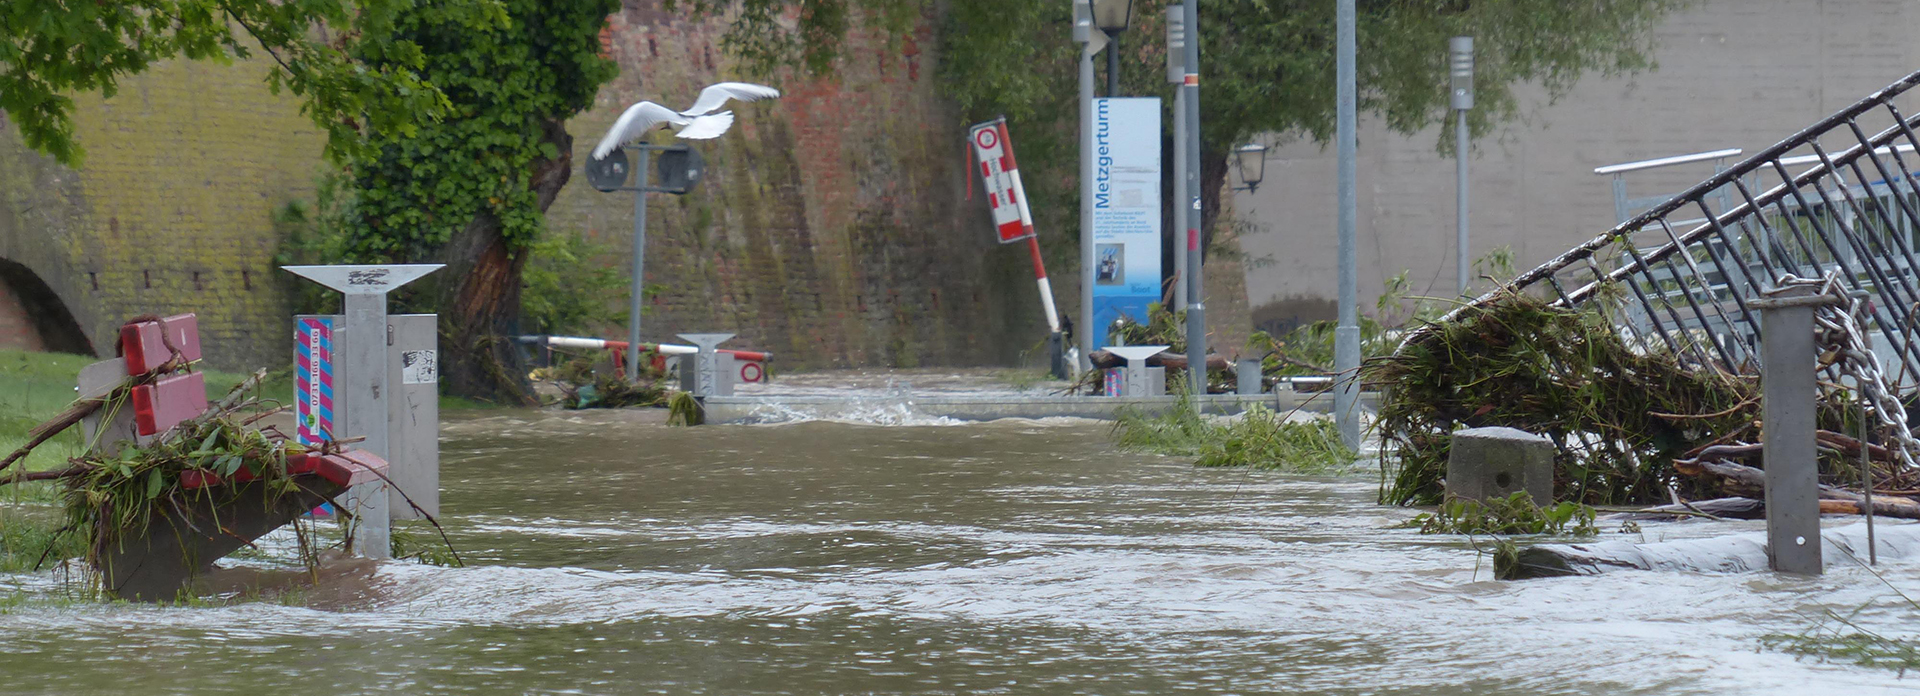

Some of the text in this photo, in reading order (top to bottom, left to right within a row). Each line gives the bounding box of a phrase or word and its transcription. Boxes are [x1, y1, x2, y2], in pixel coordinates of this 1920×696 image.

[1094, 98, 1112, 208] Metzgerturm
[312, 331, 319, 344] 66
[312, 346, 319, 358] 33
